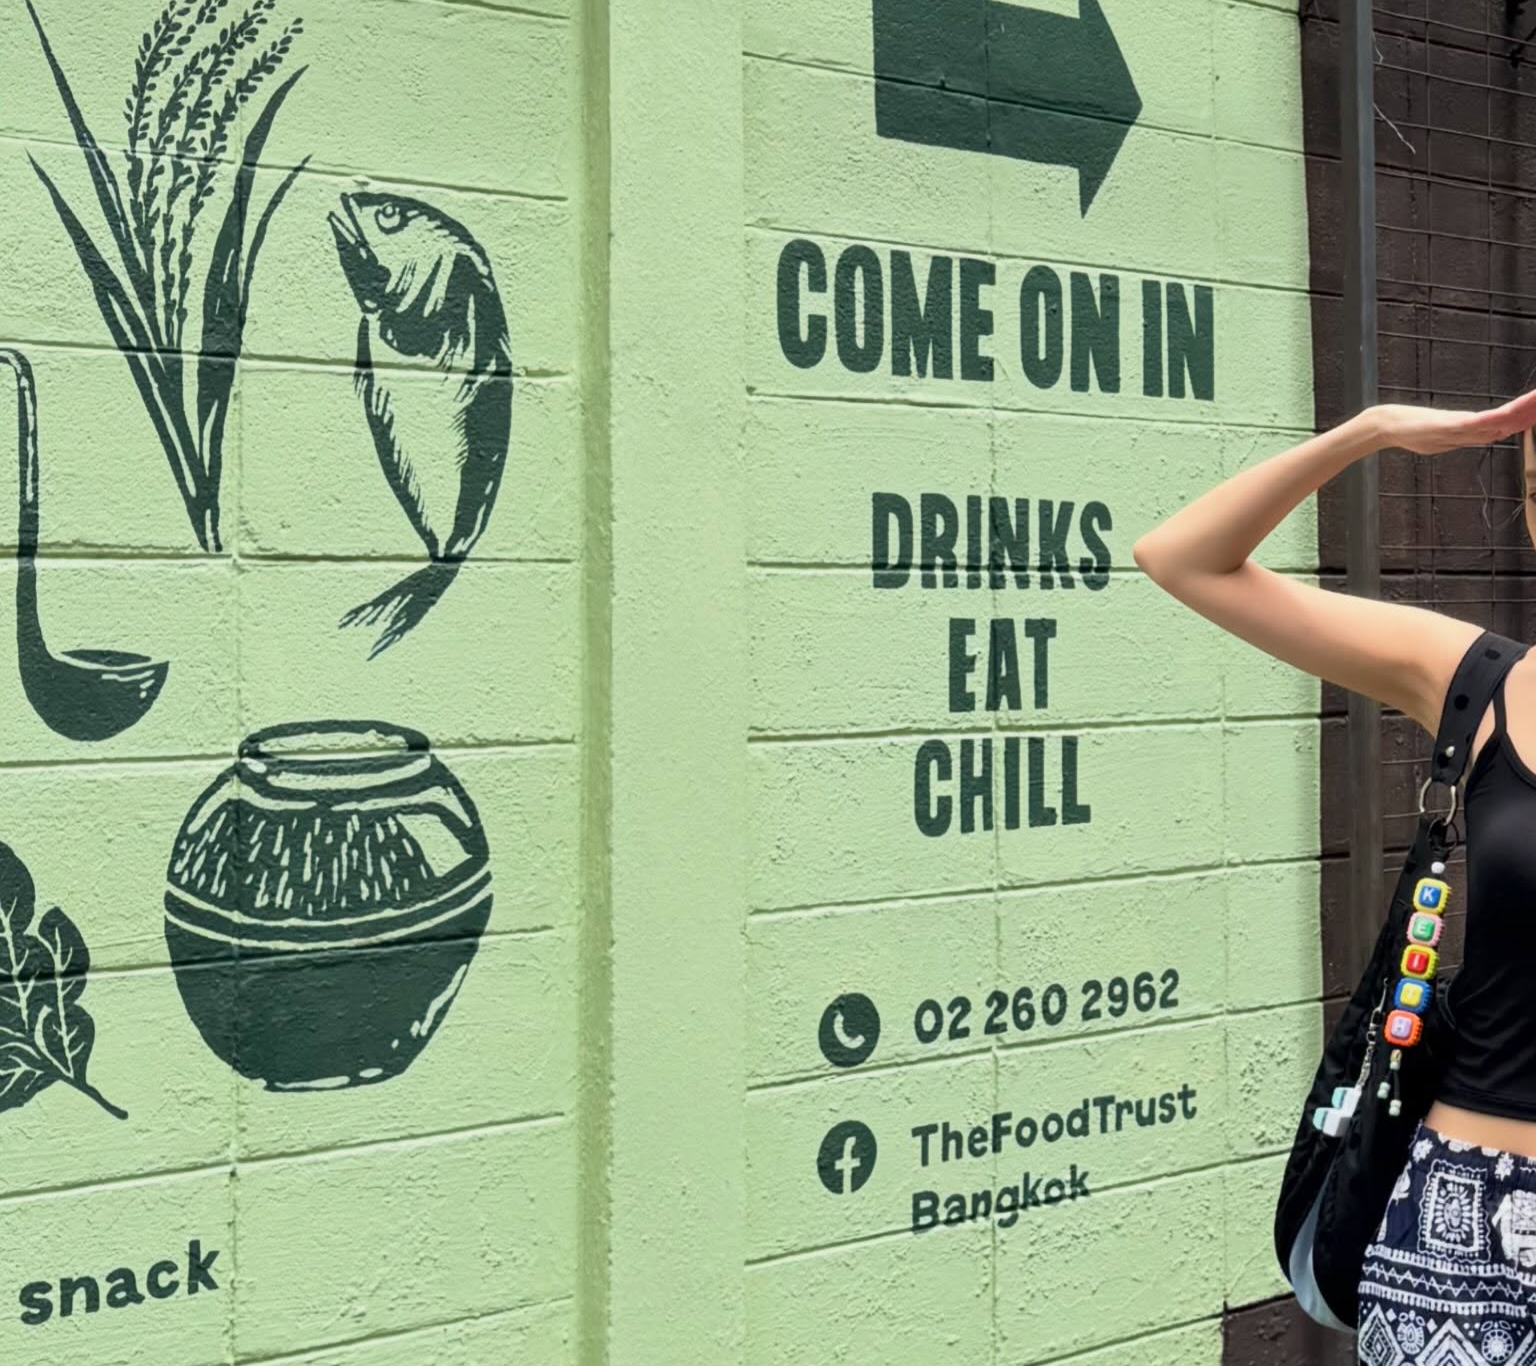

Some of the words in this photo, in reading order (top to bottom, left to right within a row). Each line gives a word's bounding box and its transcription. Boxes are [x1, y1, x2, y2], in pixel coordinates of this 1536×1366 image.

[777, 239, 996, 382] COME
[1020, 265, 1121, 393] ON
[1142, 279, 1215, 401] IN
[871, 492, 1112, 591] DRINKS
[948, 617, 1057, 713] EAT
[914, 735, 1091, 837] CHILL
[914, 996, 972, 1044] 02
[984, 983, 1067, 1035] 260
[1081, 968, 1179, 1021] 2962
[911, 1084, 1197, 1167] TheFoodTrust
[911, 1165, 1091, 1235] Bangkok
[19, 1239, 219, 1325] snack
